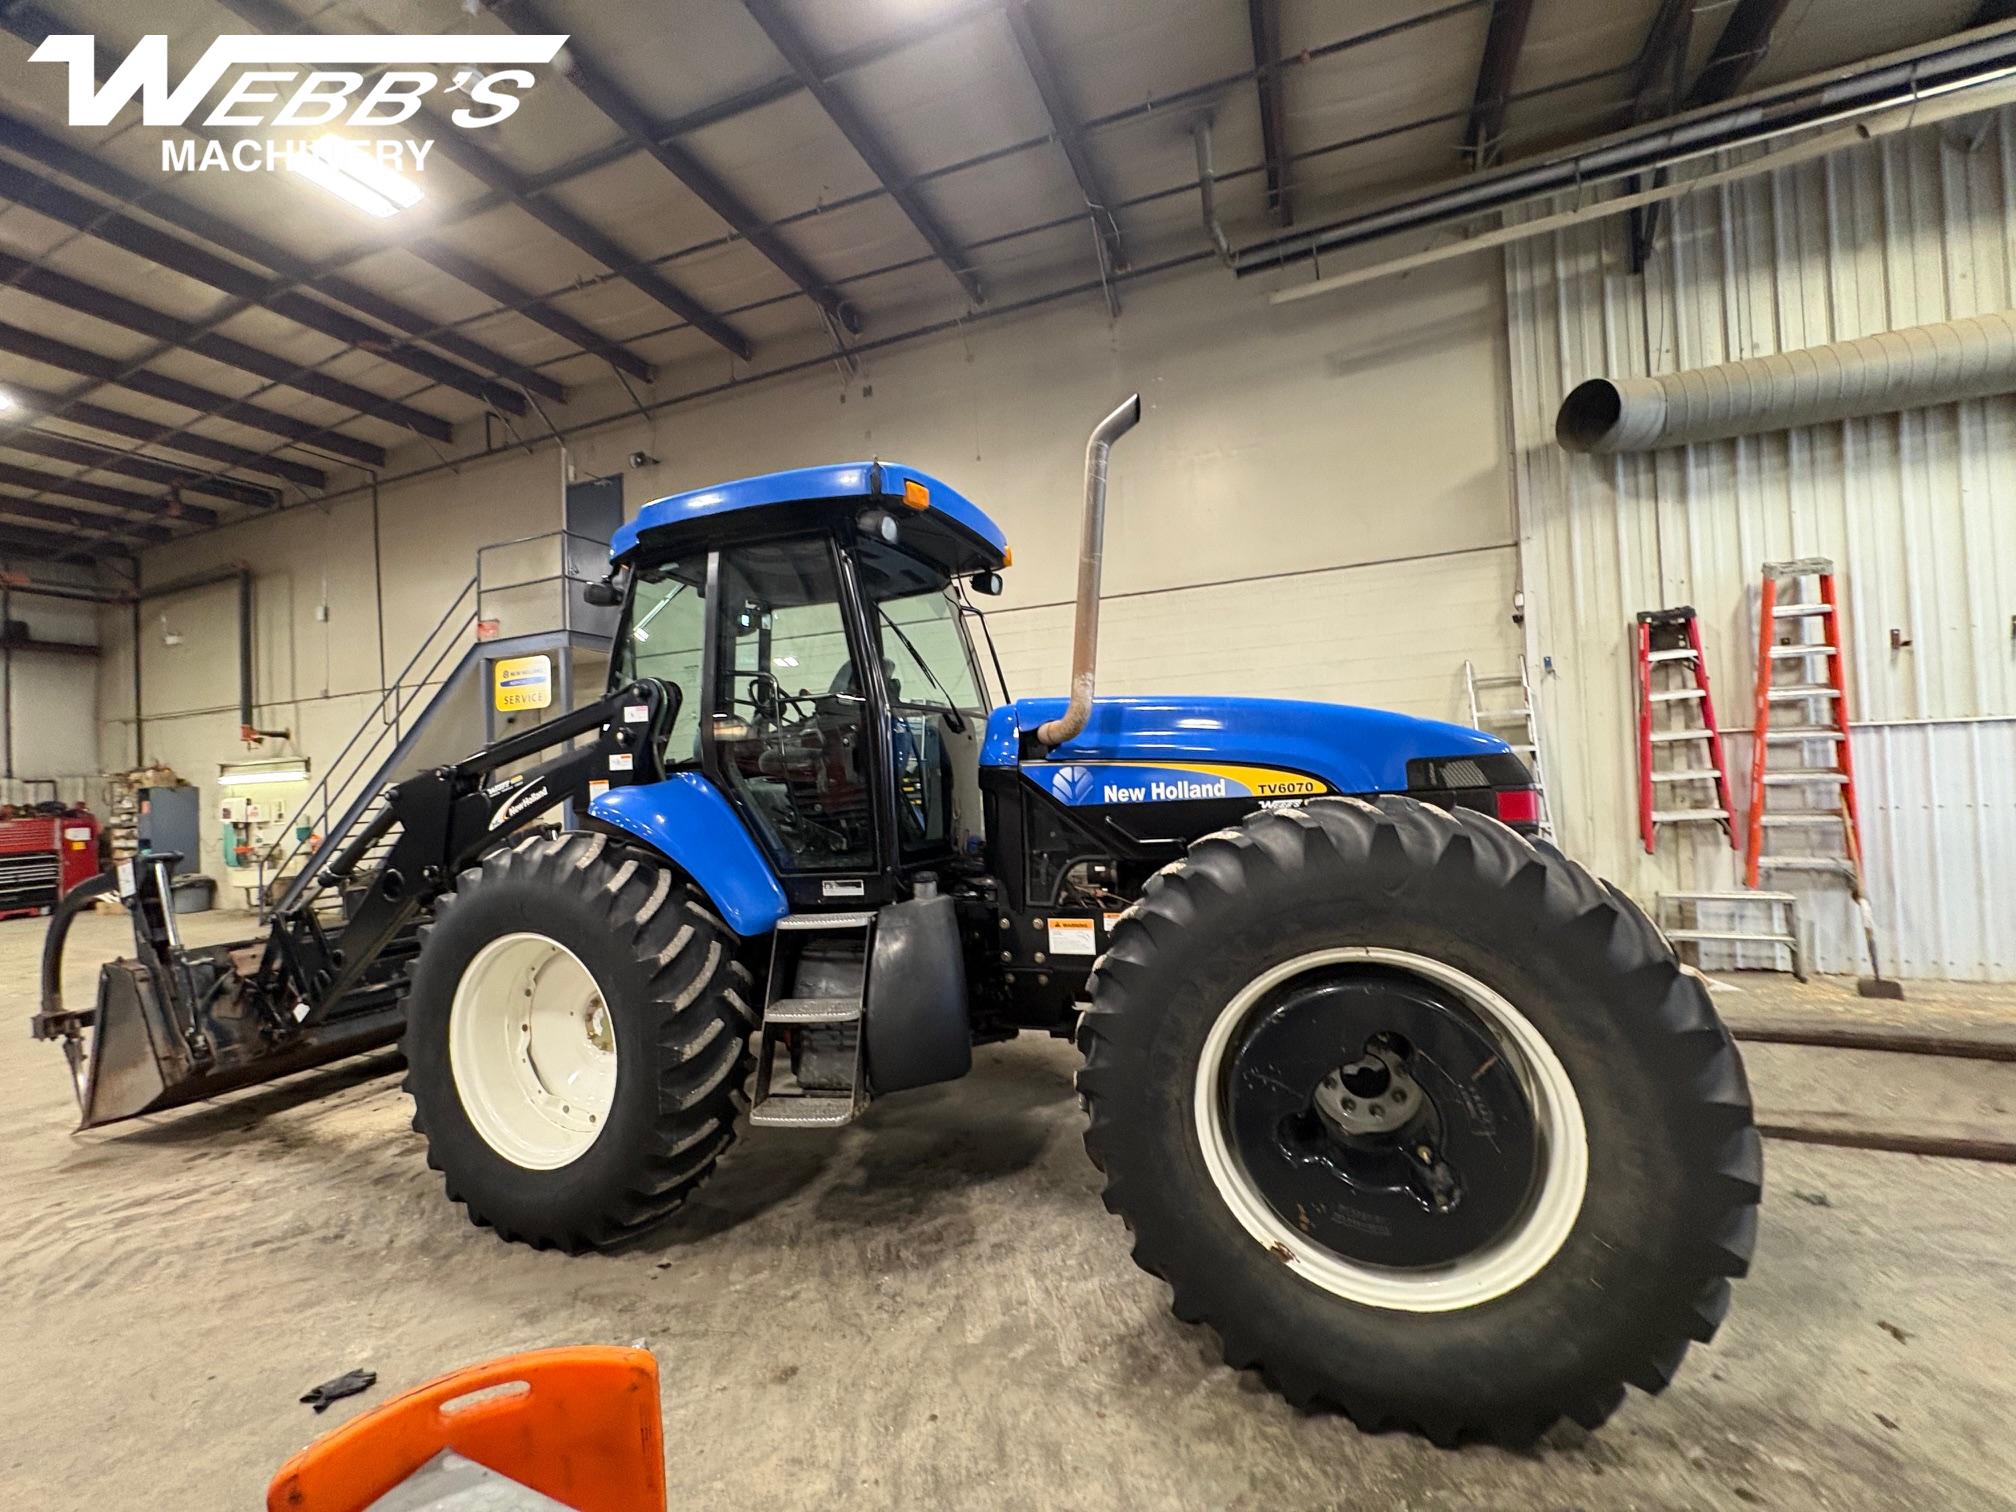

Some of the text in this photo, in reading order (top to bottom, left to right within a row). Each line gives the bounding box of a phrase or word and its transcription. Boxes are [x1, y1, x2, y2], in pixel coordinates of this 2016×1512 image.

[504, 693, 543, 705] SERVICE
[1104, 778, 1225, 803] New Holland
[1258, 782, 1314, 794] TV6070
